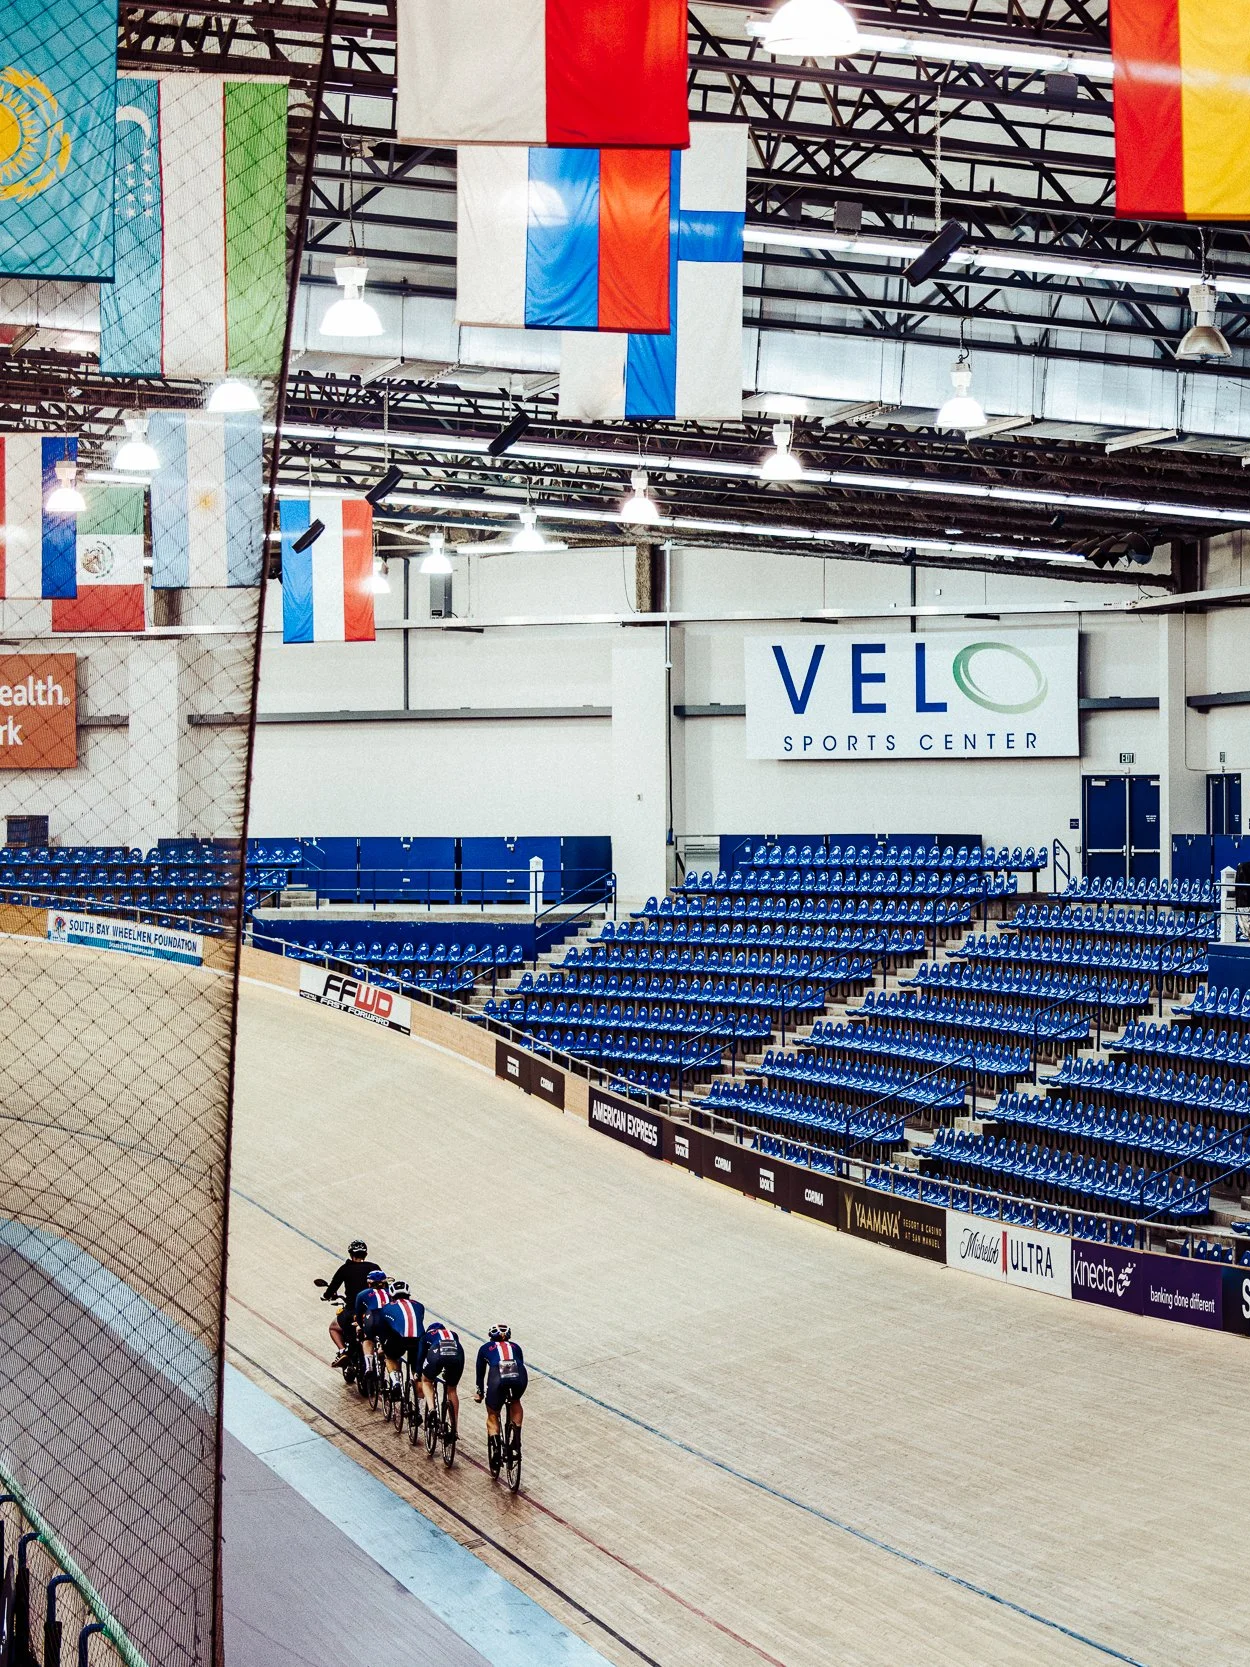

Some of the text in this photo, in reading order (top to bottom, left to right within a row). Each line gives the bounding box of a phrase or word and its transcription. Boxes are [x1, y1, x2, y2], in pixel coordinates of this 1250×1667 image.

[0, 675, 64, 707] ealth
[0, 715, 23, 746] rk
[783, 732, 1038, 752] SPORTS CENTER
[69, 919, 94, 934] SOUTH
[96, 923, 110, 936] BAY
[112, 926, 151, 944] WHEELMEN
[154, 933, 198, 953] FOUNDATION
[322, 973, 393, 1018] FFWD
[320, 997, 390, 1027] FAST FORWARD
[592, 1099, 658, 1147] AMERICAN EXPRESS
[714, 1155, 732, 1173] CORIMA
[804, 1188, 824, 1207] CORIMA
[903, 1218, 919, 1230] RESORT
[925, 1224, 942, 1237] CASINO
[904, 1231, 940, 1249] AT SAN MANUEL
[960, 1228, 1054, 1279] Michelob ULTRA
[1072, 1249, 1115, 1293] kinecta
[1150, 1284, 1216, 1314] banking done different
